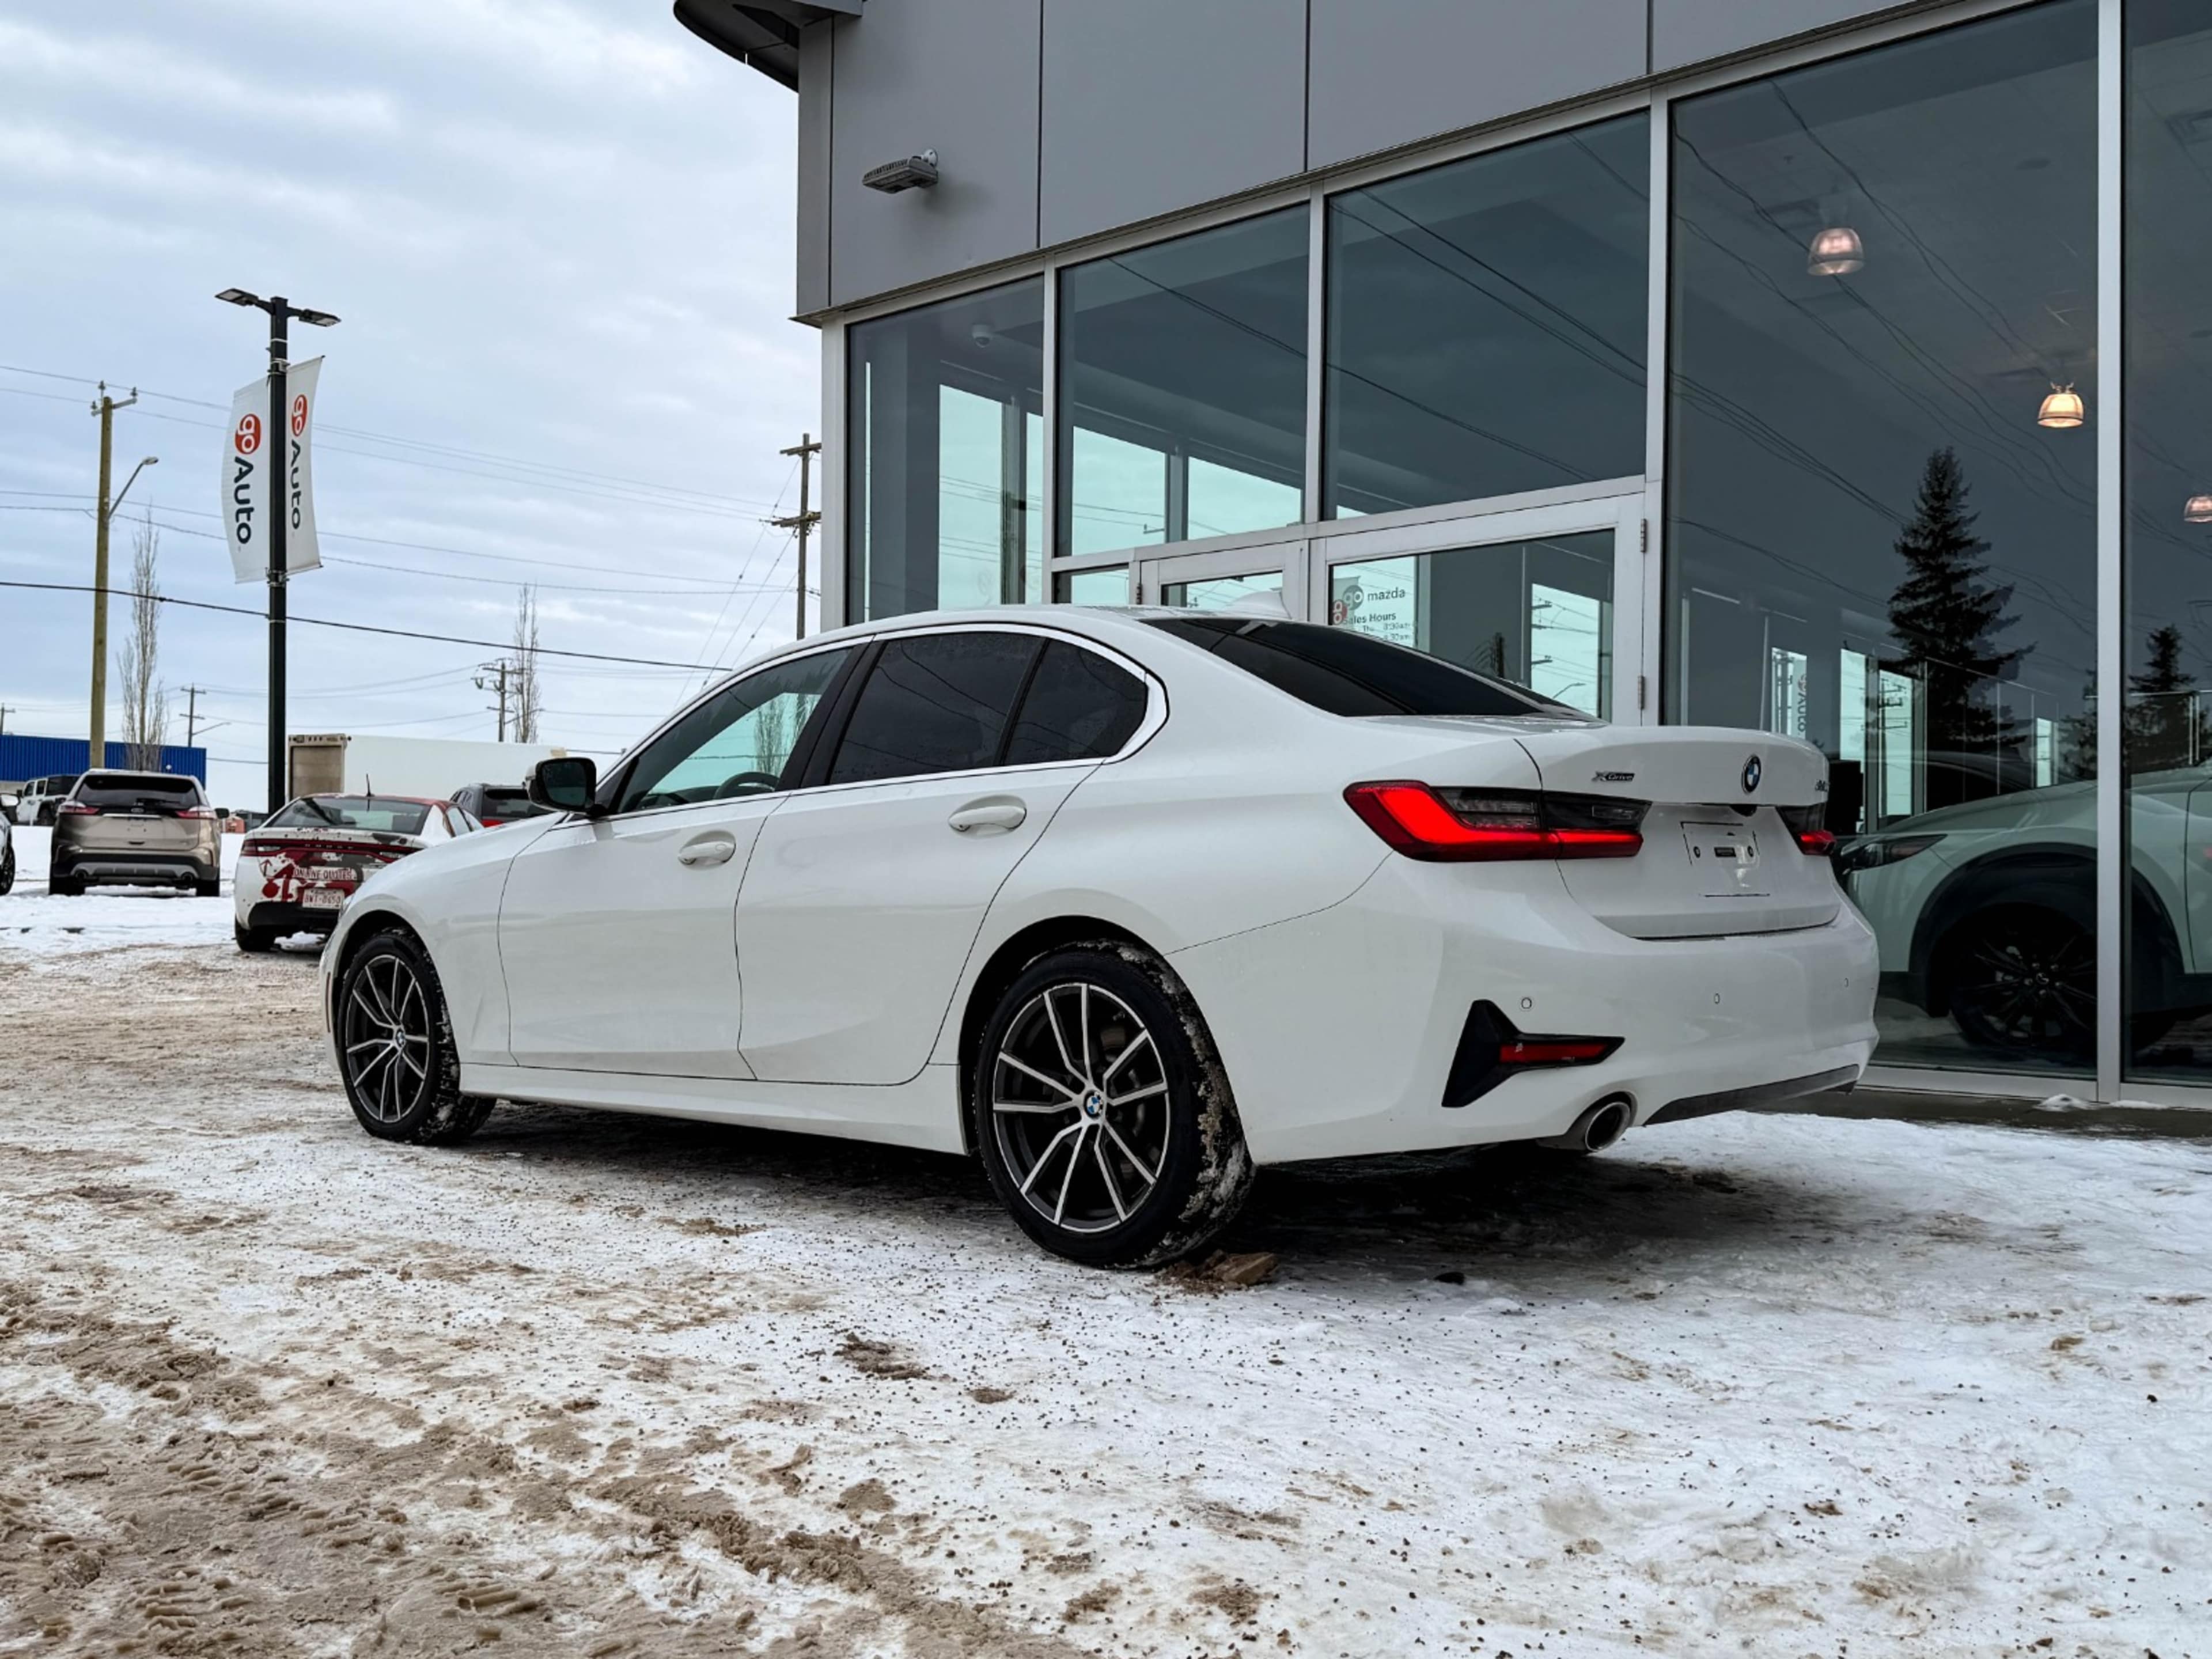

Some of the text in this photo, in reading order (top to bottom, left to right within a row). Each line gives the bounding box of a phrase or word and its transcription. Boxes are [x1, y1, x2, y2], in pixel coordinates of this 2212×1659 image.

[234, 415, 257, 544] go Auto
[290, 439, 301, 529] Auto
[1368, 587, 1406, 601] mazda
[1369, 613, 1396, 622] Hours
